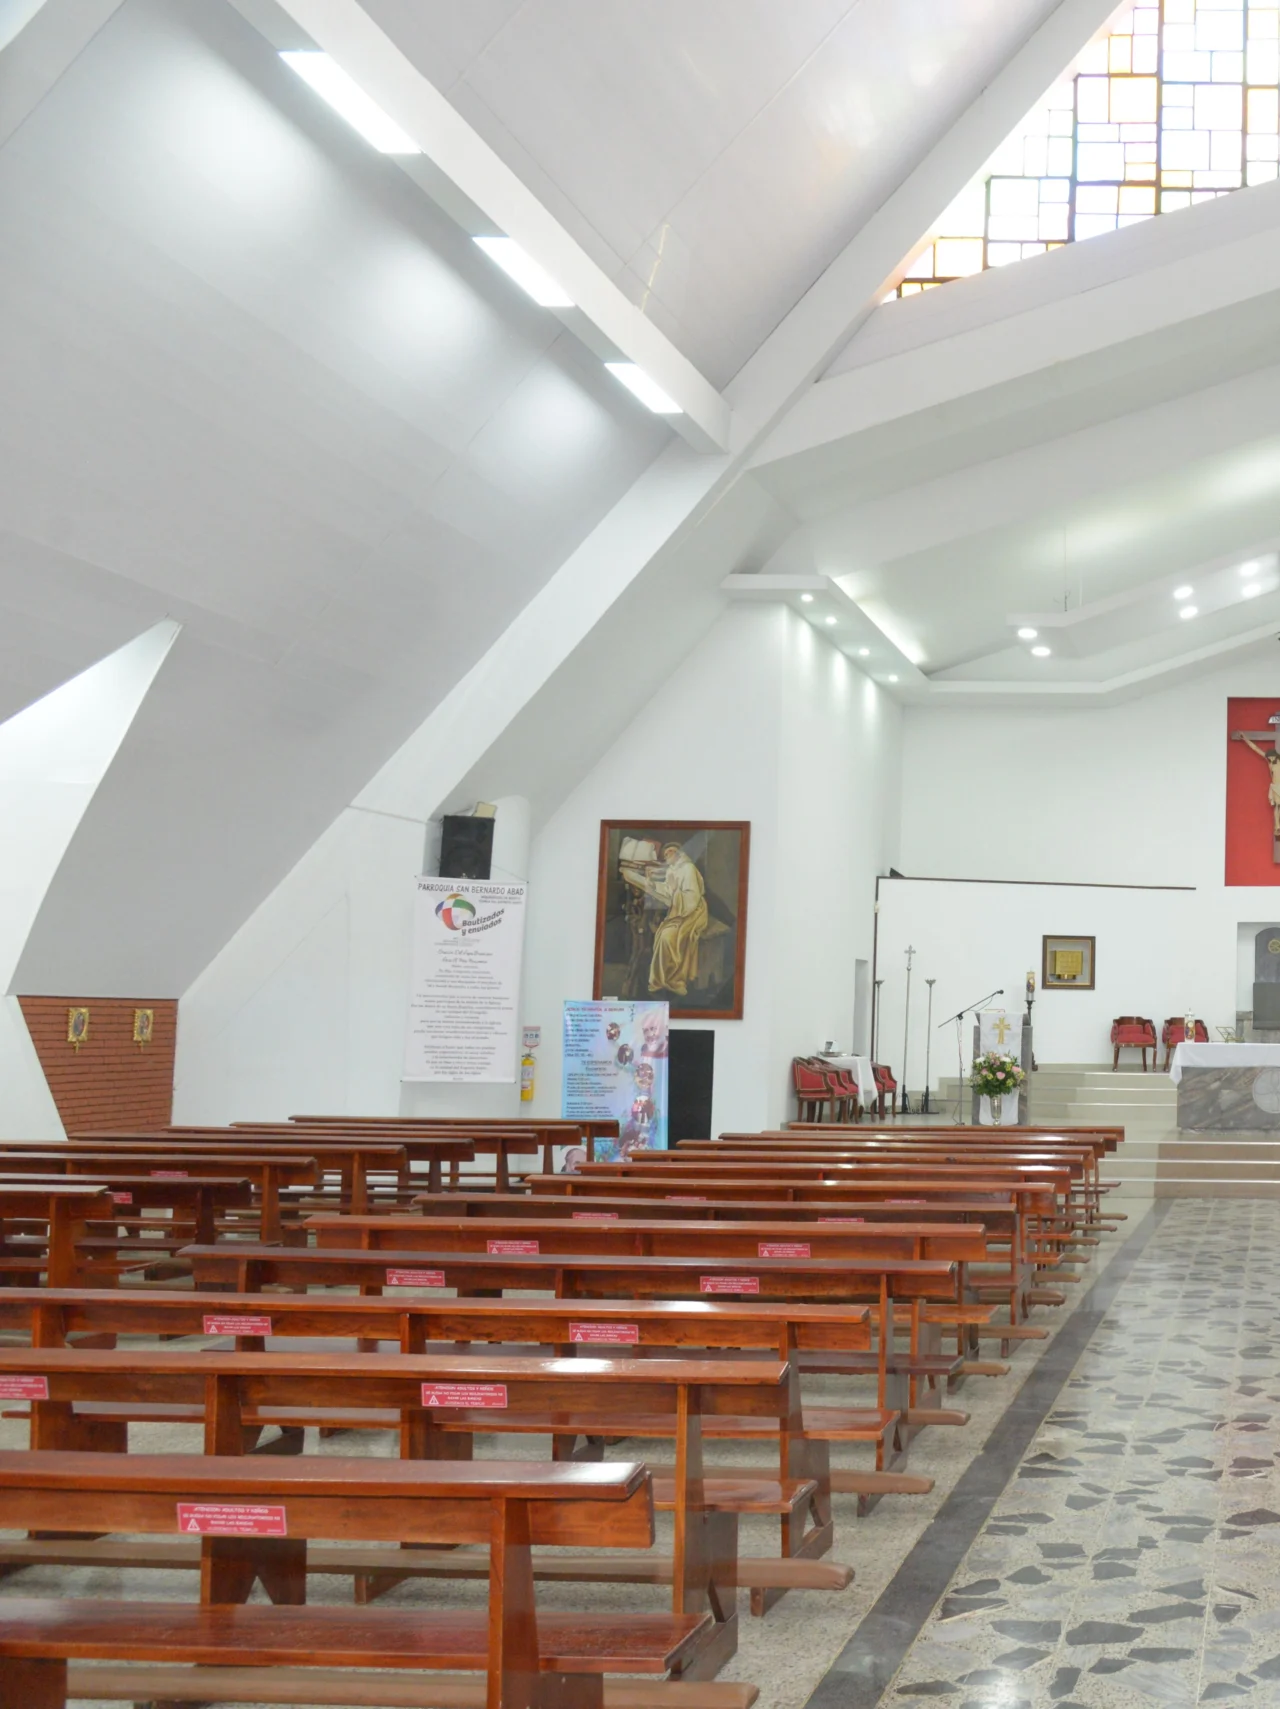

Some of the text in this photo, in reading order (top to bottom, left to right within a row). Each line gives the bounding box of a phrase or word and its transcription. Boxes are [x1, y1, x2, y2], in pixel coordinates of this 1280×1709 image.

[418, 883, 454, 892] PARROQUIA
[472, 886, 505, 895] BERNARDO
[507, 888, 524, 896] ABAD
[462, 908, 504, 927] Bautizados
[468, 918, 502, 934] enviados
